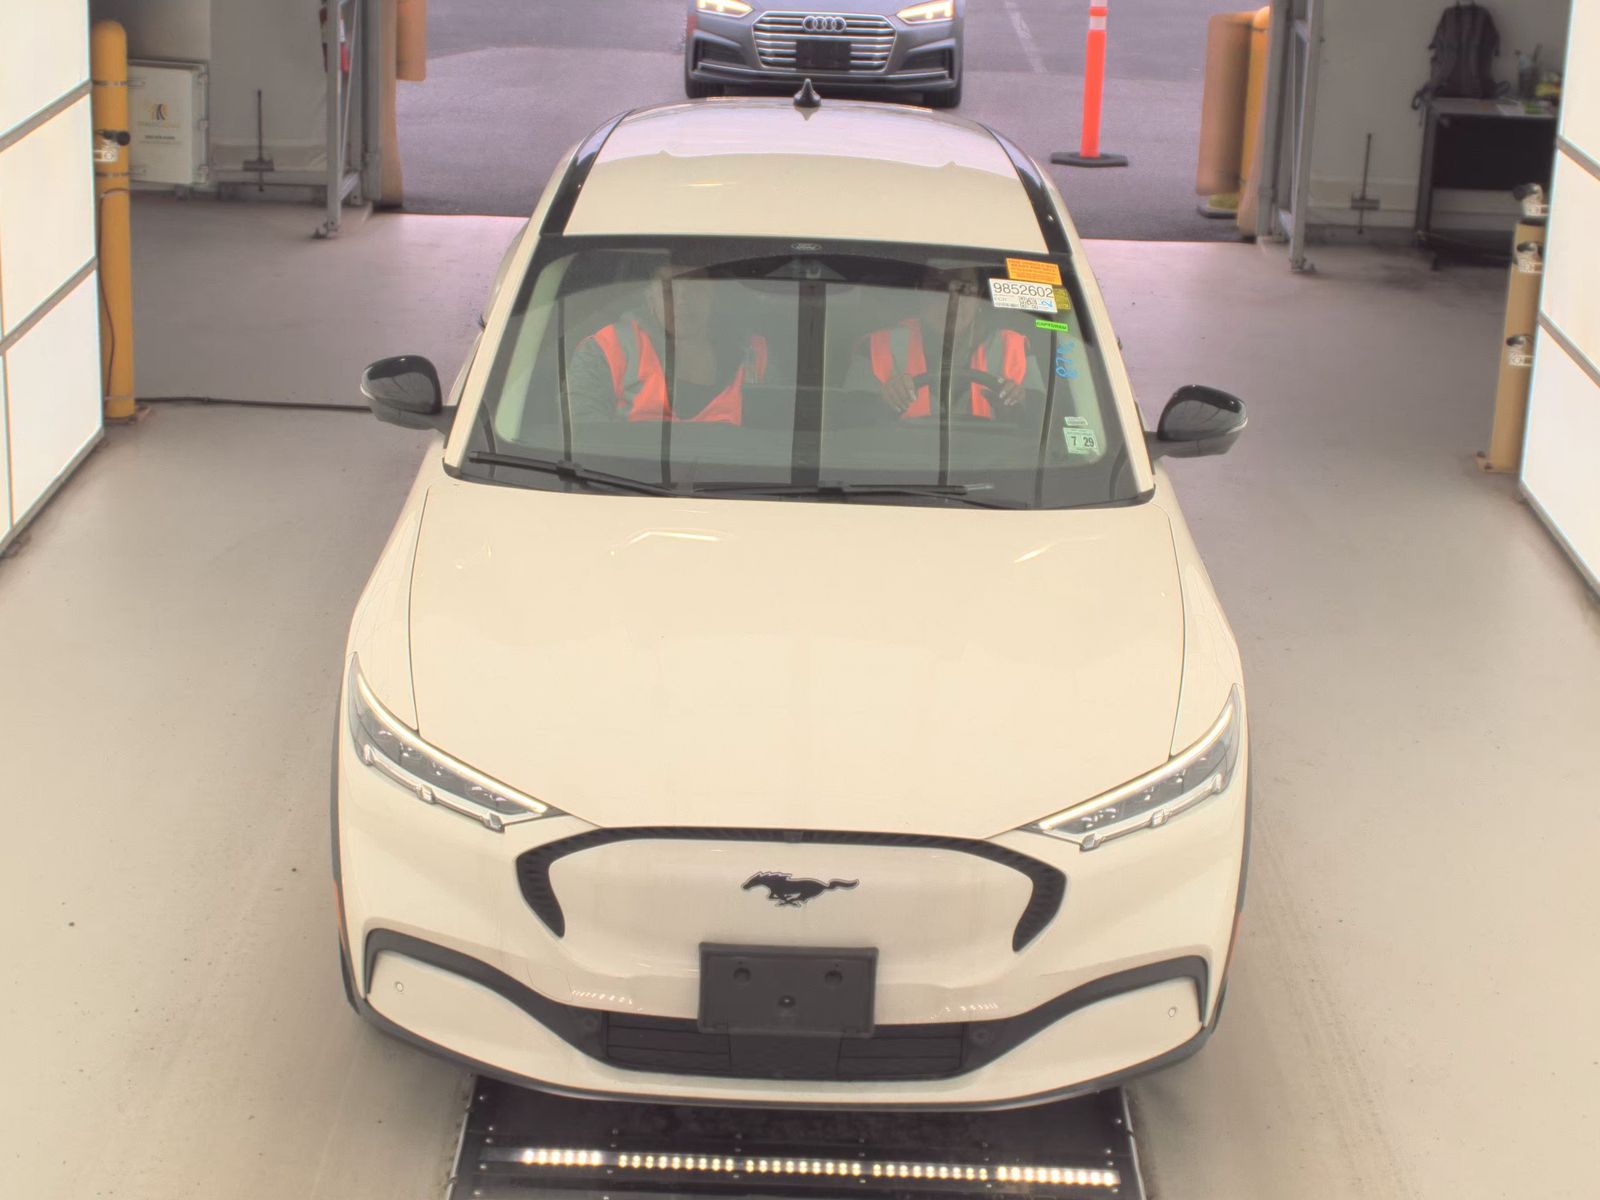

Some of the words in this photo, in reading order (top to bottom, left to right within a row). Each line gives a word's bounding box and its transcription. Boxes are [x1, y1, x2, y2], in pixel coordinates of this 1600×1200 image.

[993, 282, 1054, 298] 9852602
[1071, 436, 1077, 446] 7
[1083, 436, 1095, 448] 29
